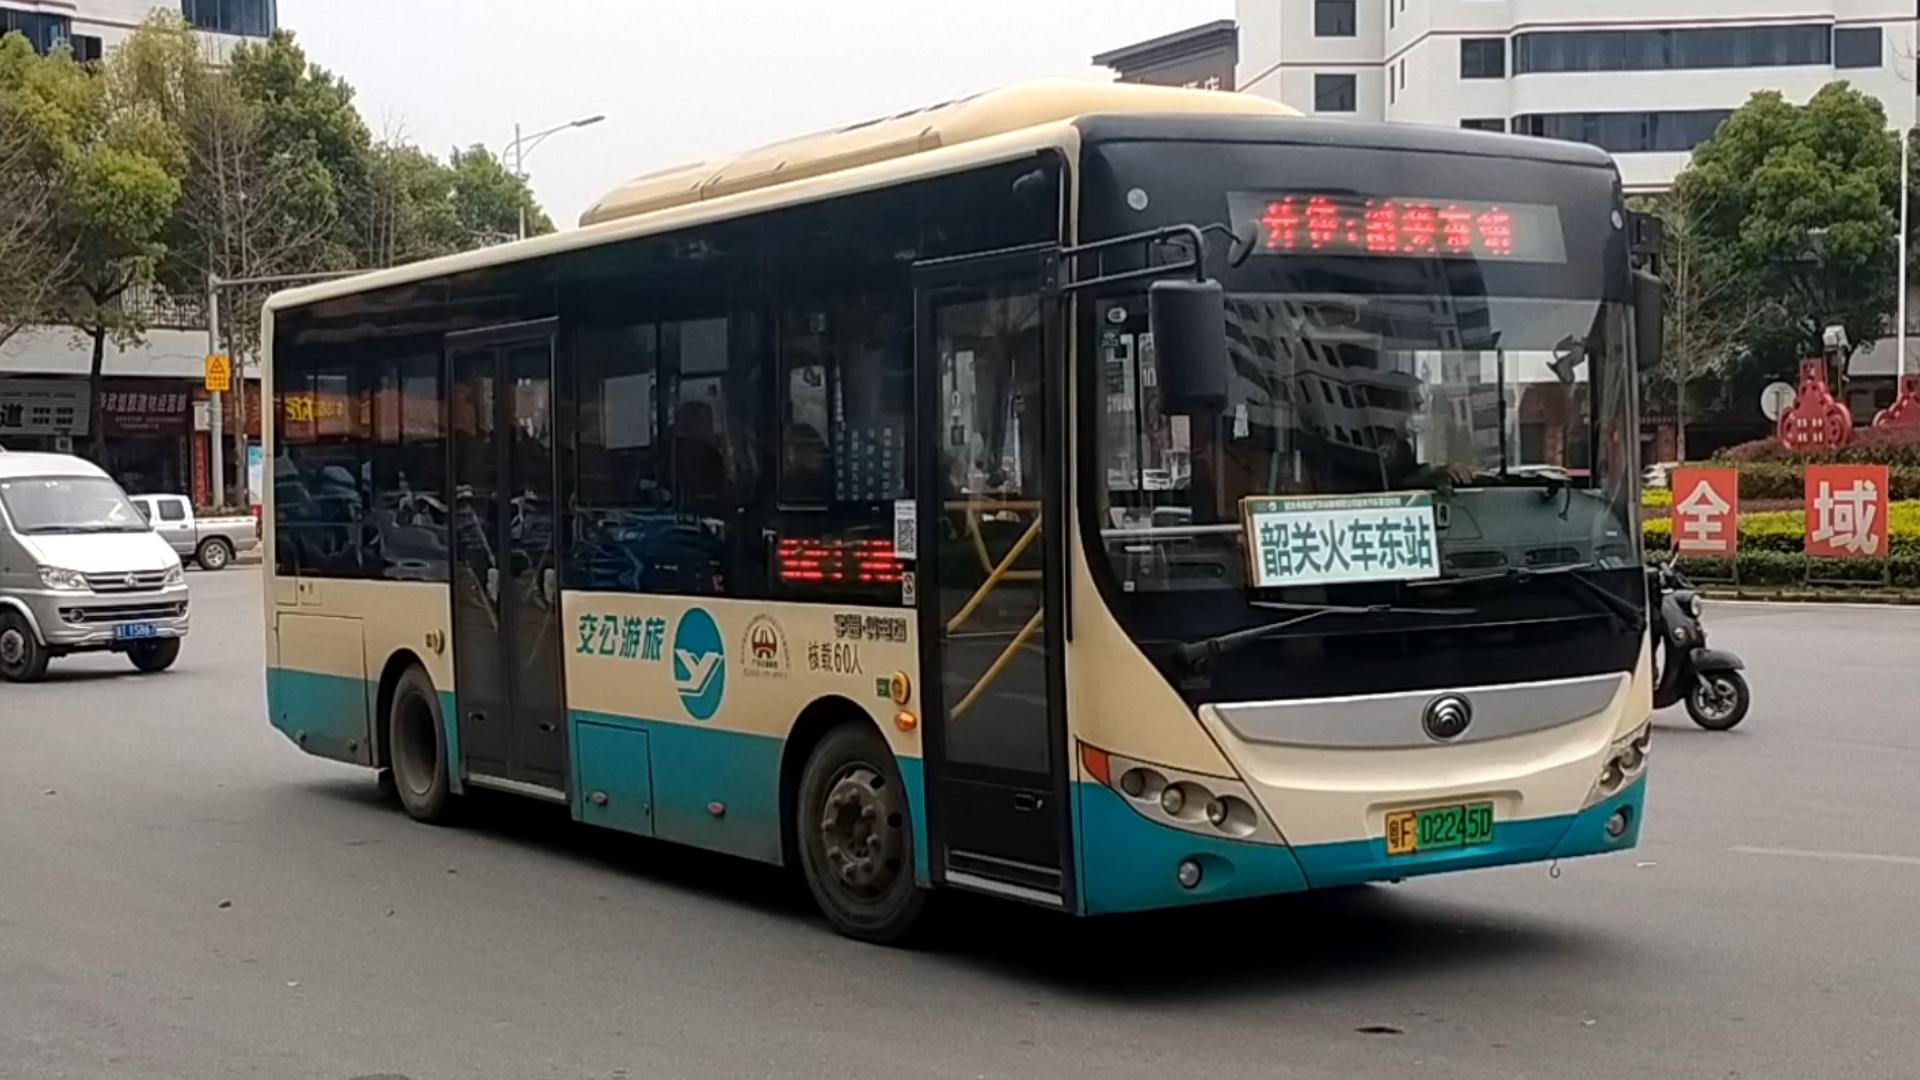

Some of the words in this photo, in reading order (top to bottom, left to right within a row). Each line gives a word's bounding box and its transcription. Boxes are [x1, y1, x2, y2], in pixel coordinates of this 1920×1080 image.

[1260, 515, 1434, 577] 韶关火车东站
[1676, 480, 1731, 550] 全
[1812, 480, 1879, 554] 域
